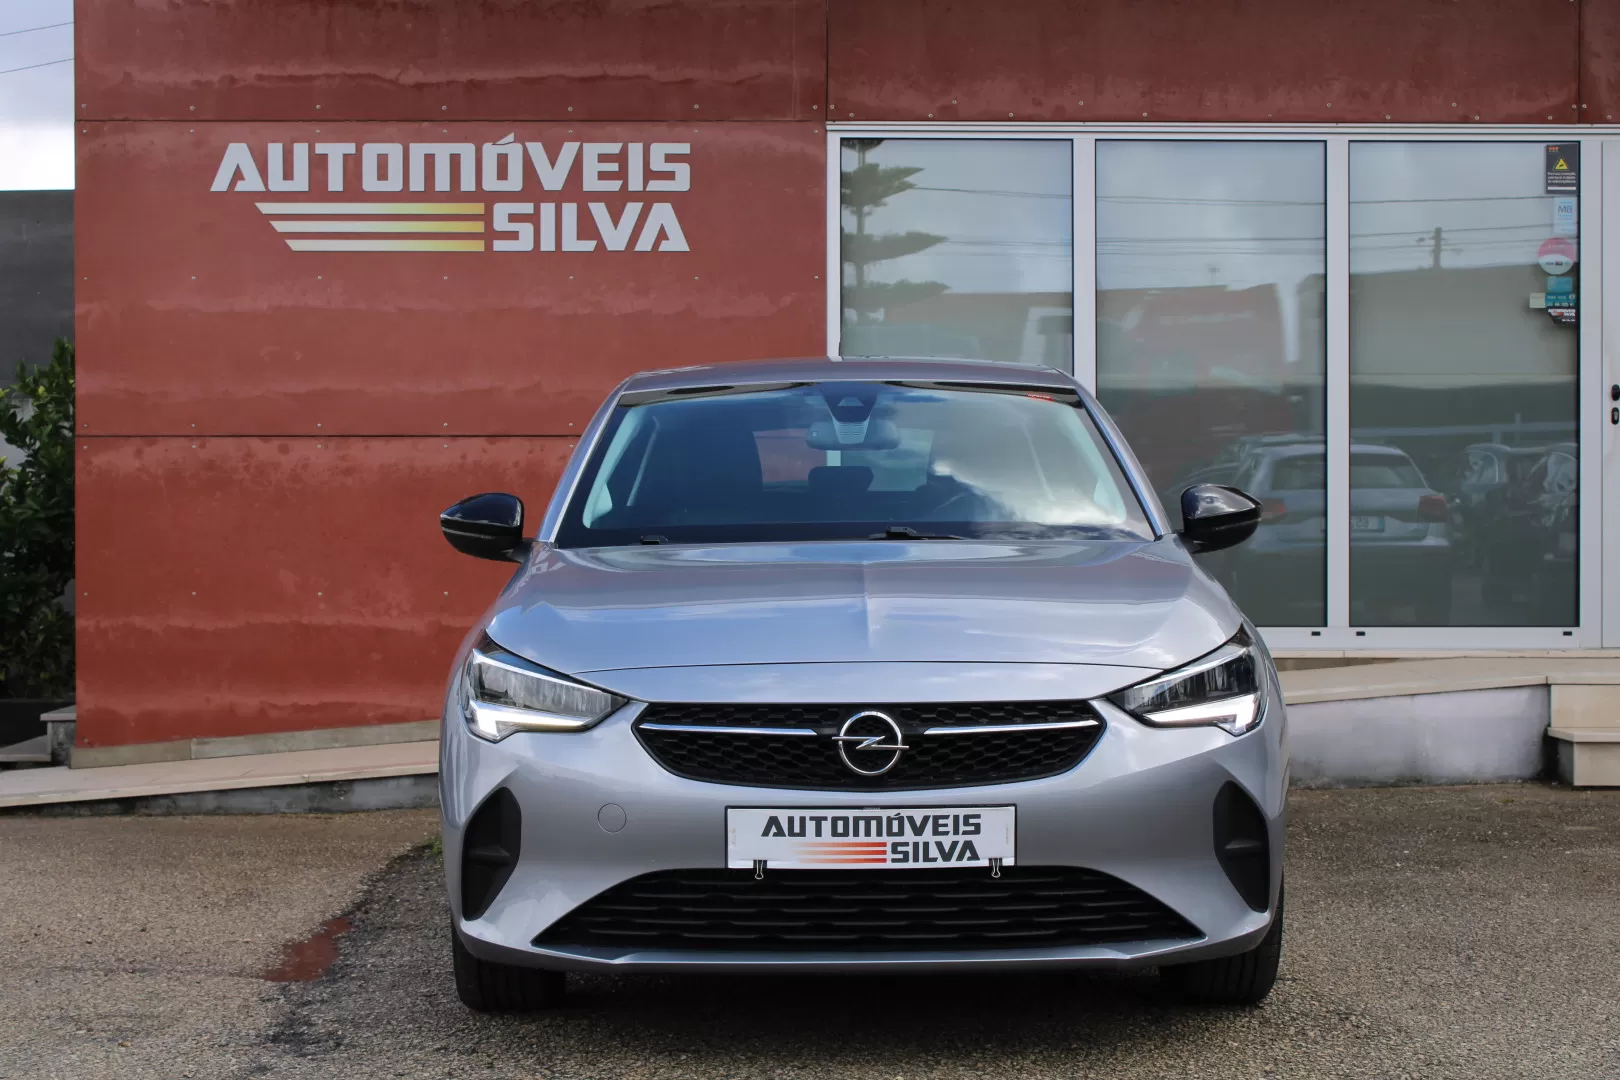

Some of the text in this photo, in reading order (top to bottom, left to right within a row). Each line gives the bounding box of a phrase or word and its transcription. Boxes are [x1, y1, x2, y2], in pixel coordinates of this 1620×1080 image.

[210, 132, 691, 192] AUTOMÓVEIS
[493, 202, 690, 252] SILVA
[761, 812, 982, 838] AUTOMÓVEIS
[890, 840, 981, 864] SILVA
